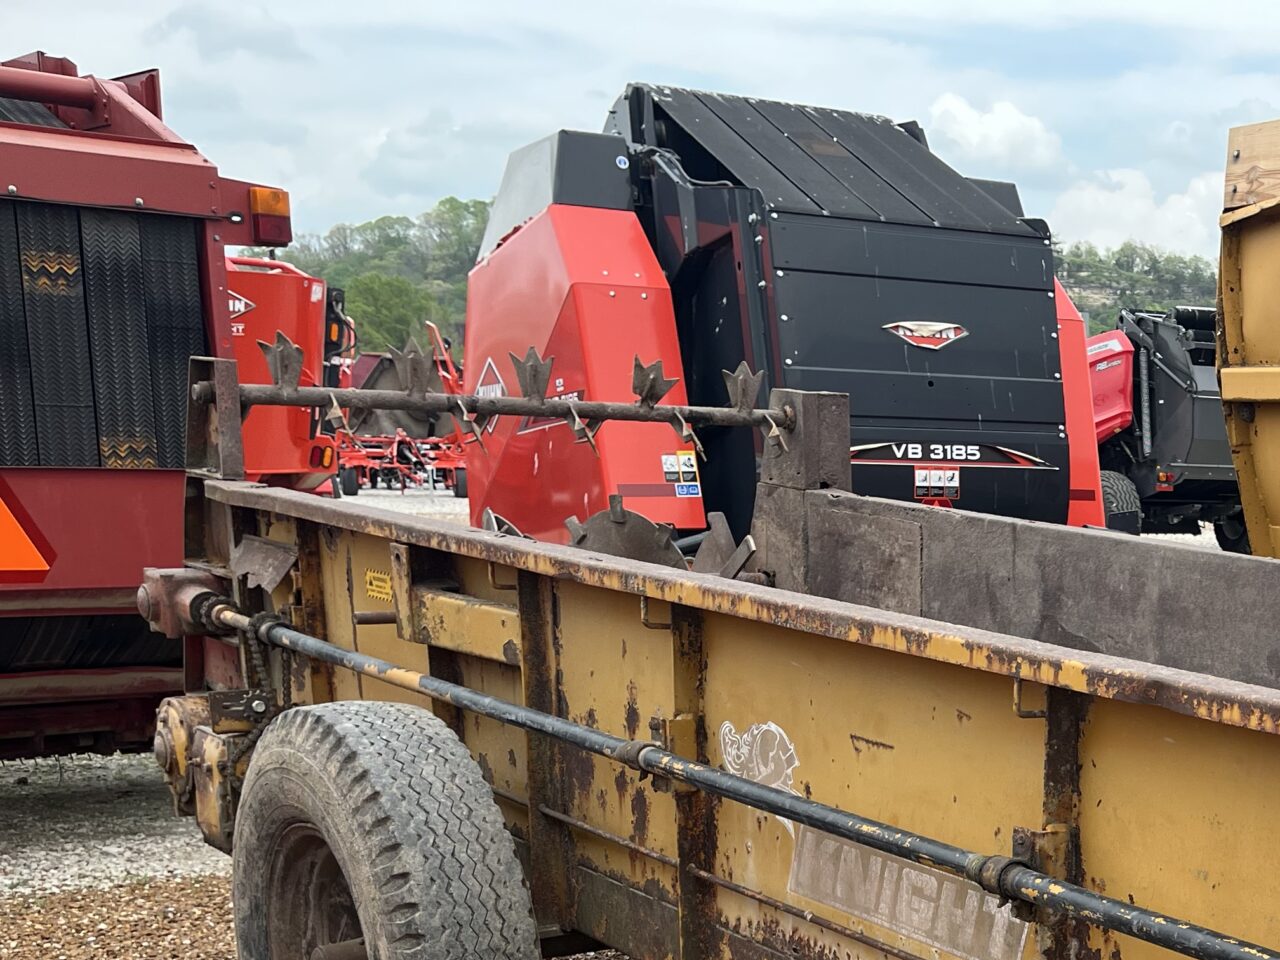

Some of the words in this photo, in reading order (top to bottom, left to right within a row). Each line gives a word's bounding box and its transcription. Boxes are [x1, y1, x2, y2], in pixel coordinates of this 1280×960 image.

[891, 443, 922, 459] VB
[929, 444, 981, 460] 3185
[799, 831, 1022, 960] KNIGHT
